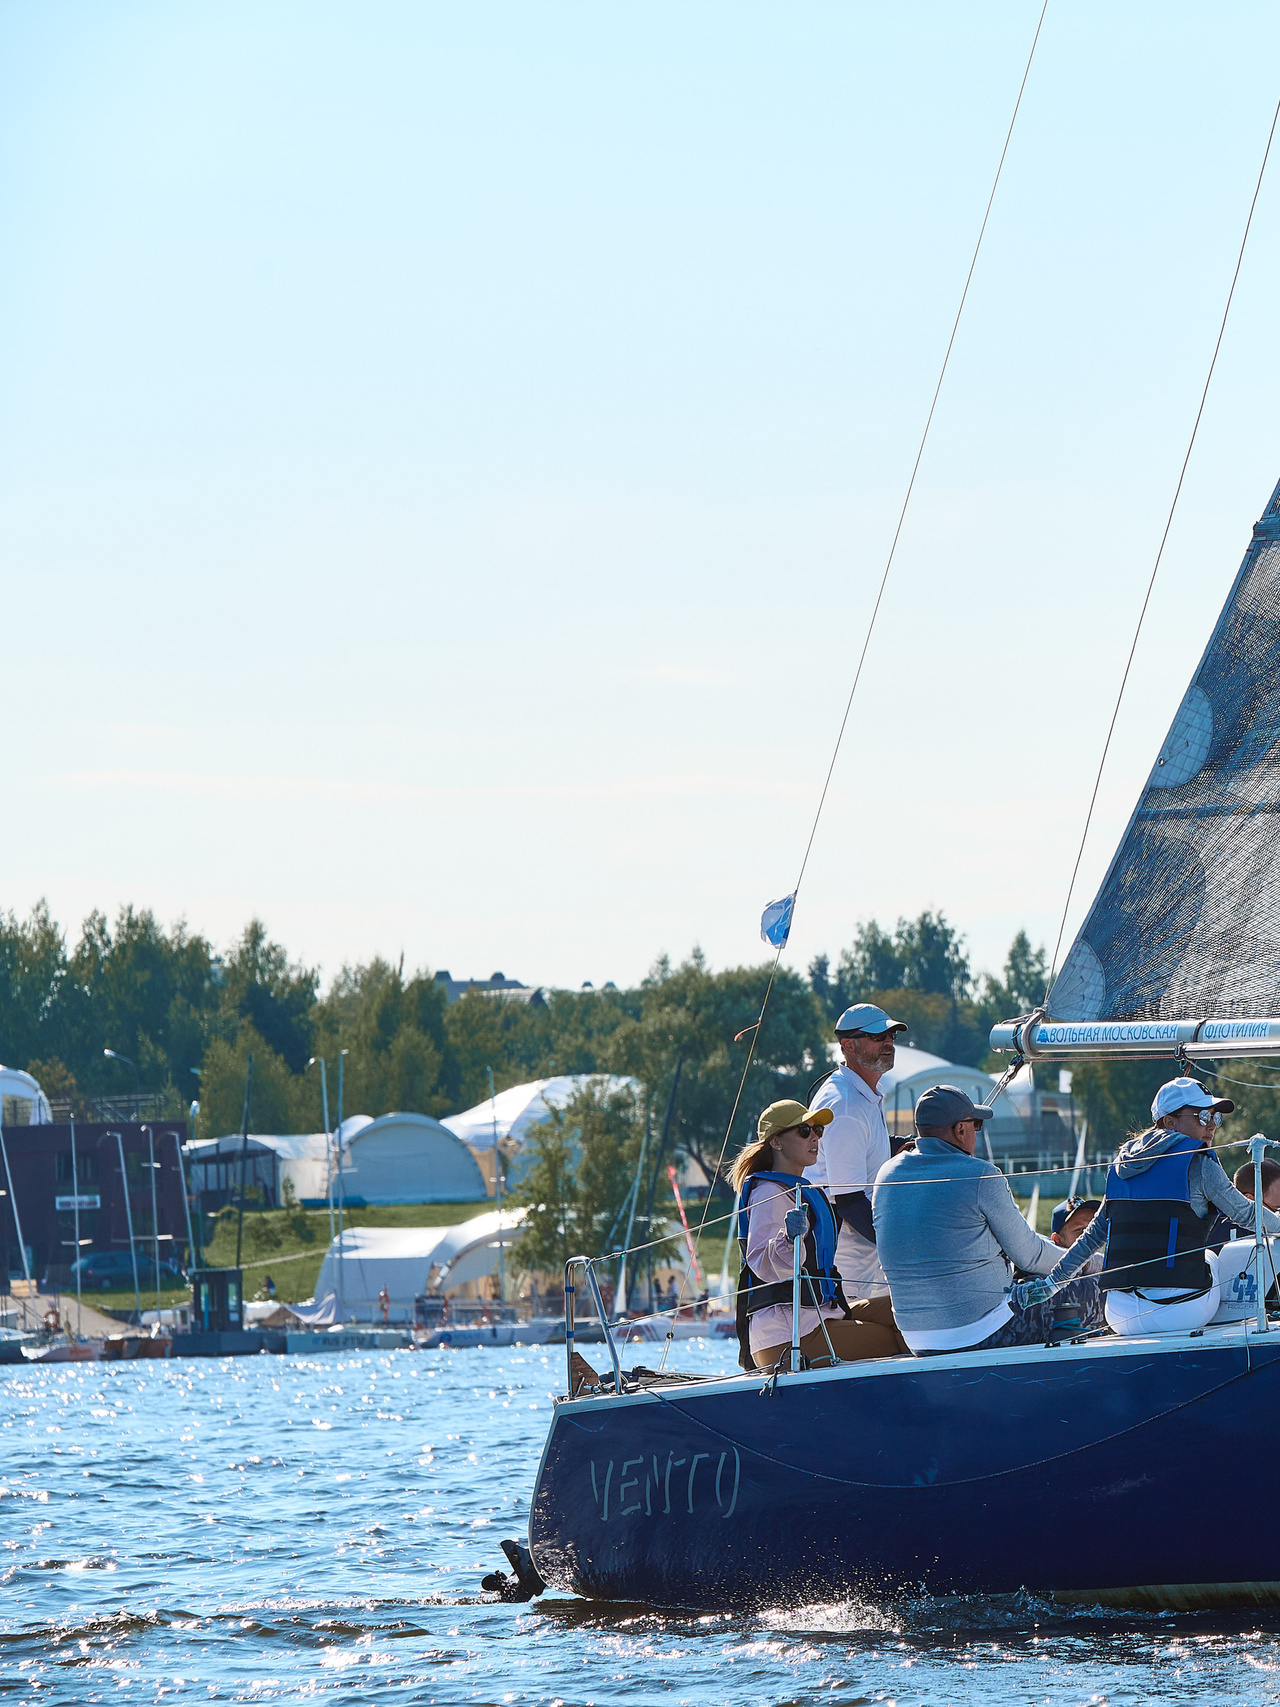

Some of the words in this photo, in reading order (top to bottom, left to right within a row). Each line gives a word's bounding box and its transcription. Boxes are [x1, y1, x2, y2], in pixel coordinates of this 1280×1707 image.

[1050, 1026, 1100, 1043] ВОЛЬНАЯ
[1101, 1023, 1178, 1042] МОСКОВСКАЯ
[1205, 1022, 1268, 1039] ФЛОТИЛИЯ
[590, 1446, 741, 1521] VENTO
